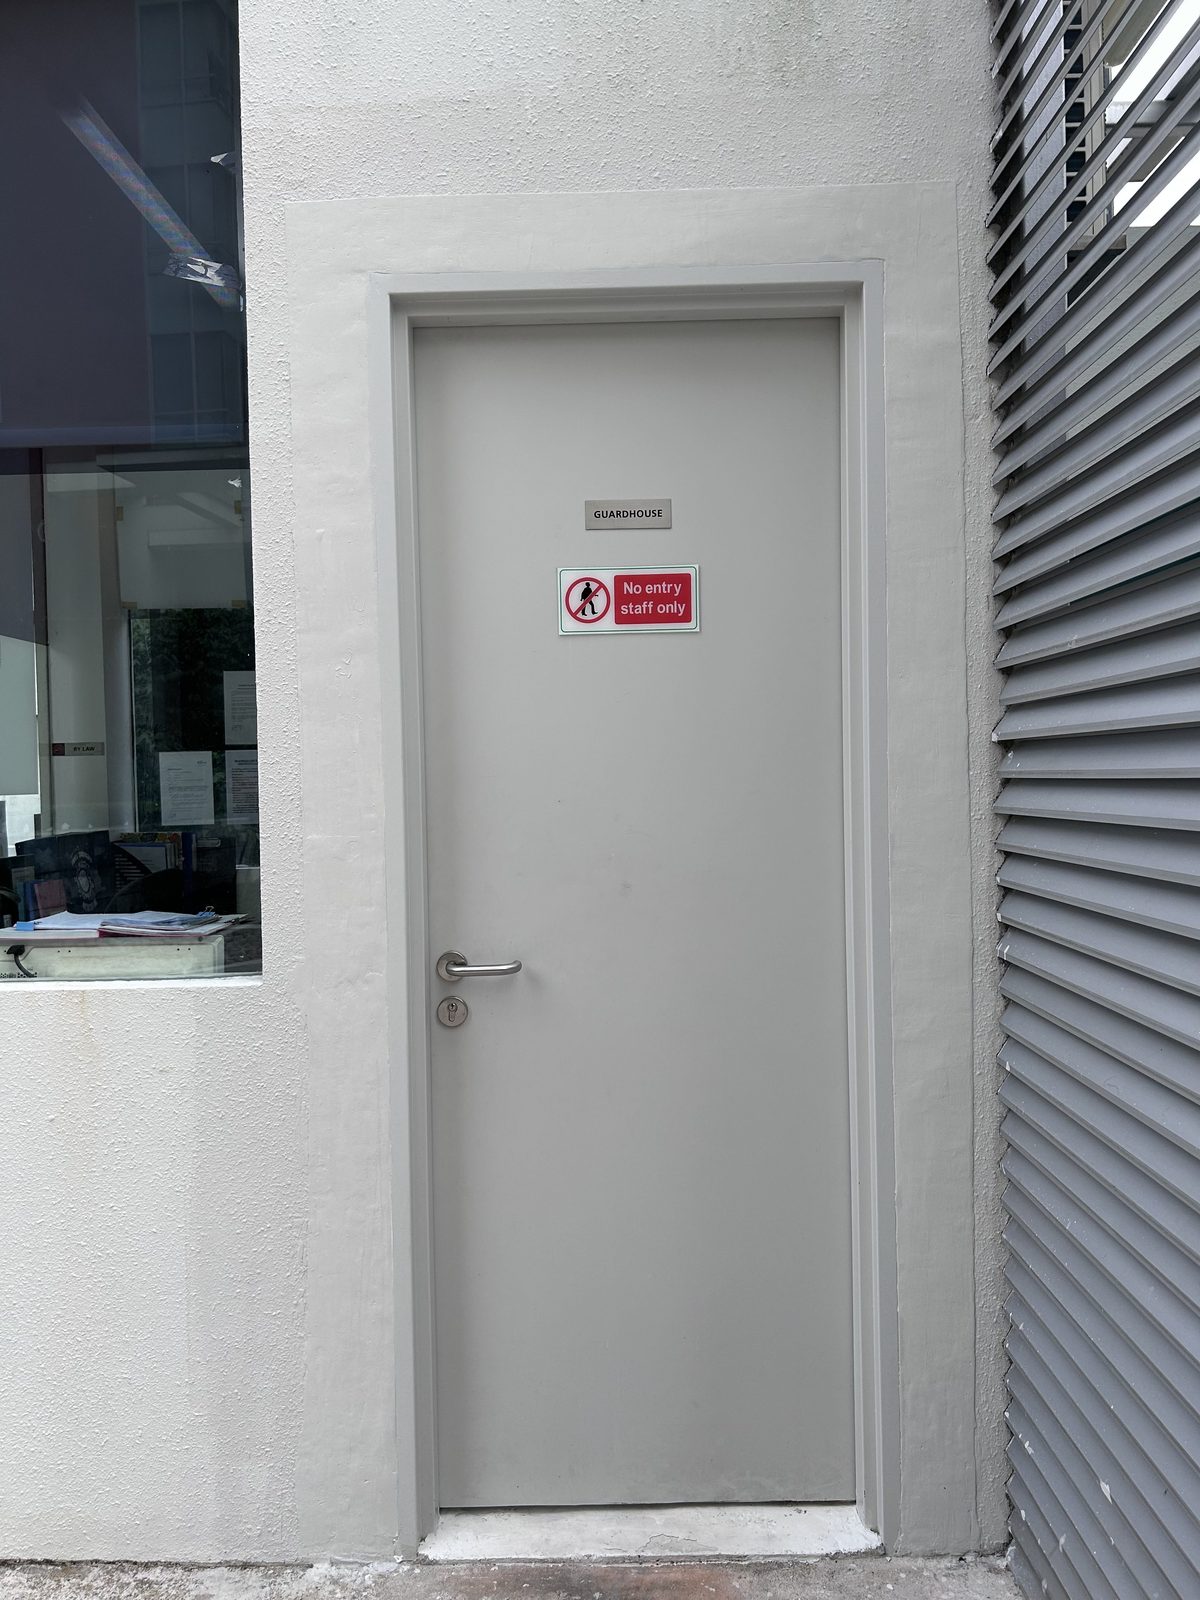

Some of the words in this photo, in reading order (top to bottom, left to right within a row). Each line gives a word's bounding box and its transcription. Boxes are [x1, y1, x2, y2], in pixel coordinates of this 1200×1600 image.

[593, 509, 663, 519] GUARDHOUSE
[623, 581, 642, 595] No
[645, 582, 682, 597] entry
[620, 601, 654, 615] staff
[656, 601, 686, 616] only
